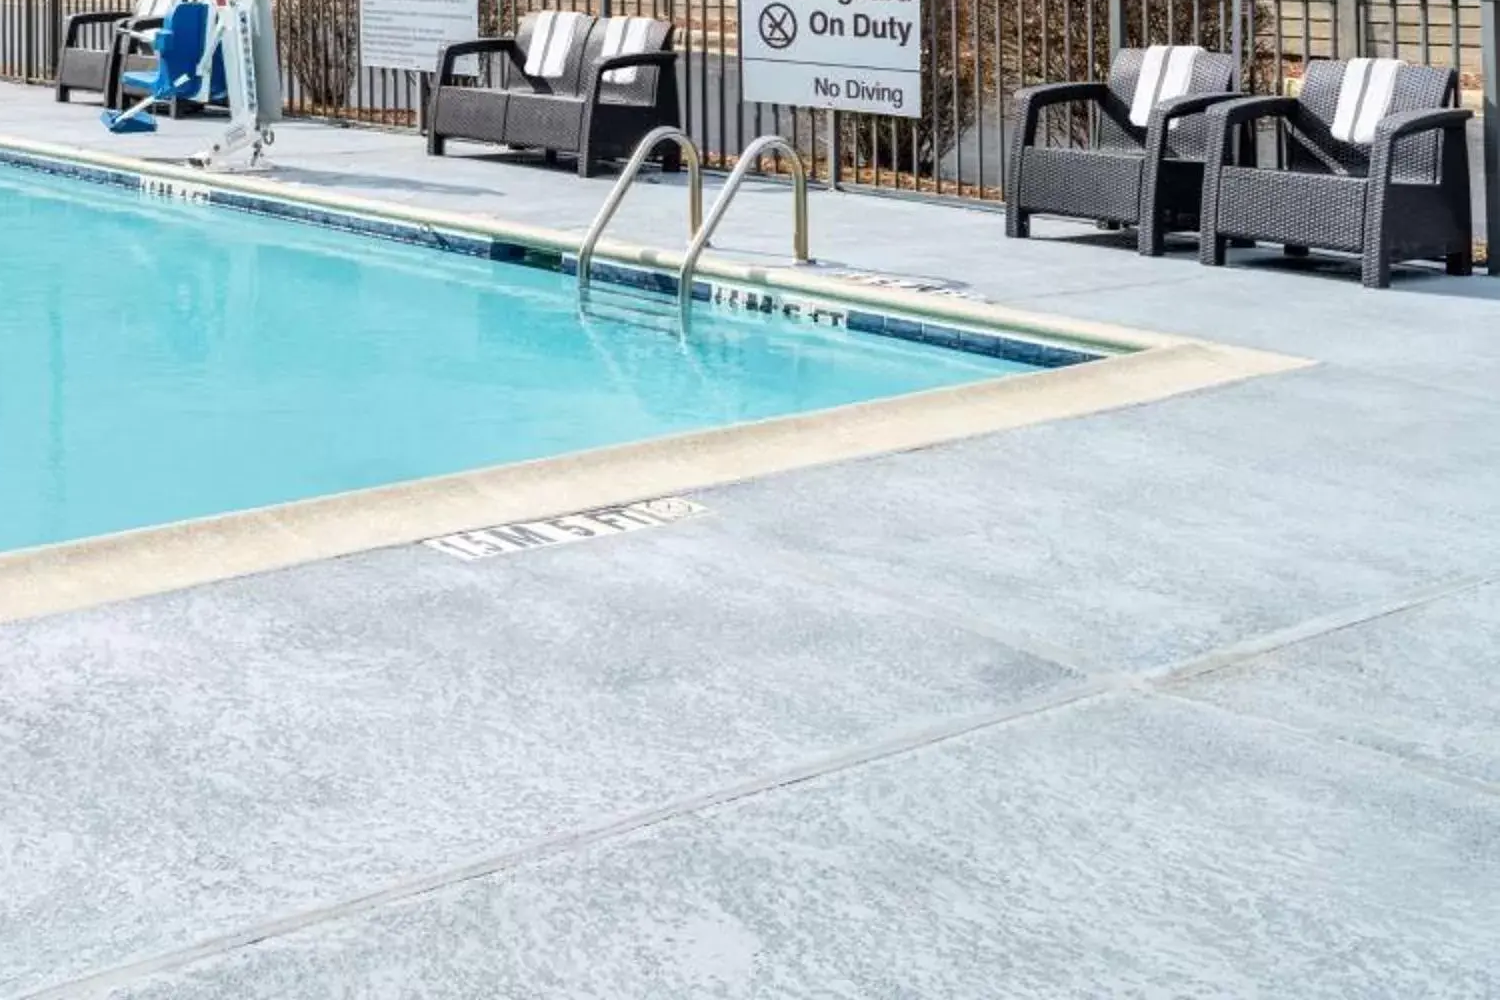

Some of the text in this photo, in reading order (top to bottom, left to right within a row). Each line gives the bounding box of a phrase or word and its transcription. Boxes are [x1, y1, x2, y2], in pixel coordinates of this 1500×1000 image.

[809, 10, 912, 47] On Duty
[814, 76, 903, 109] No Diving
